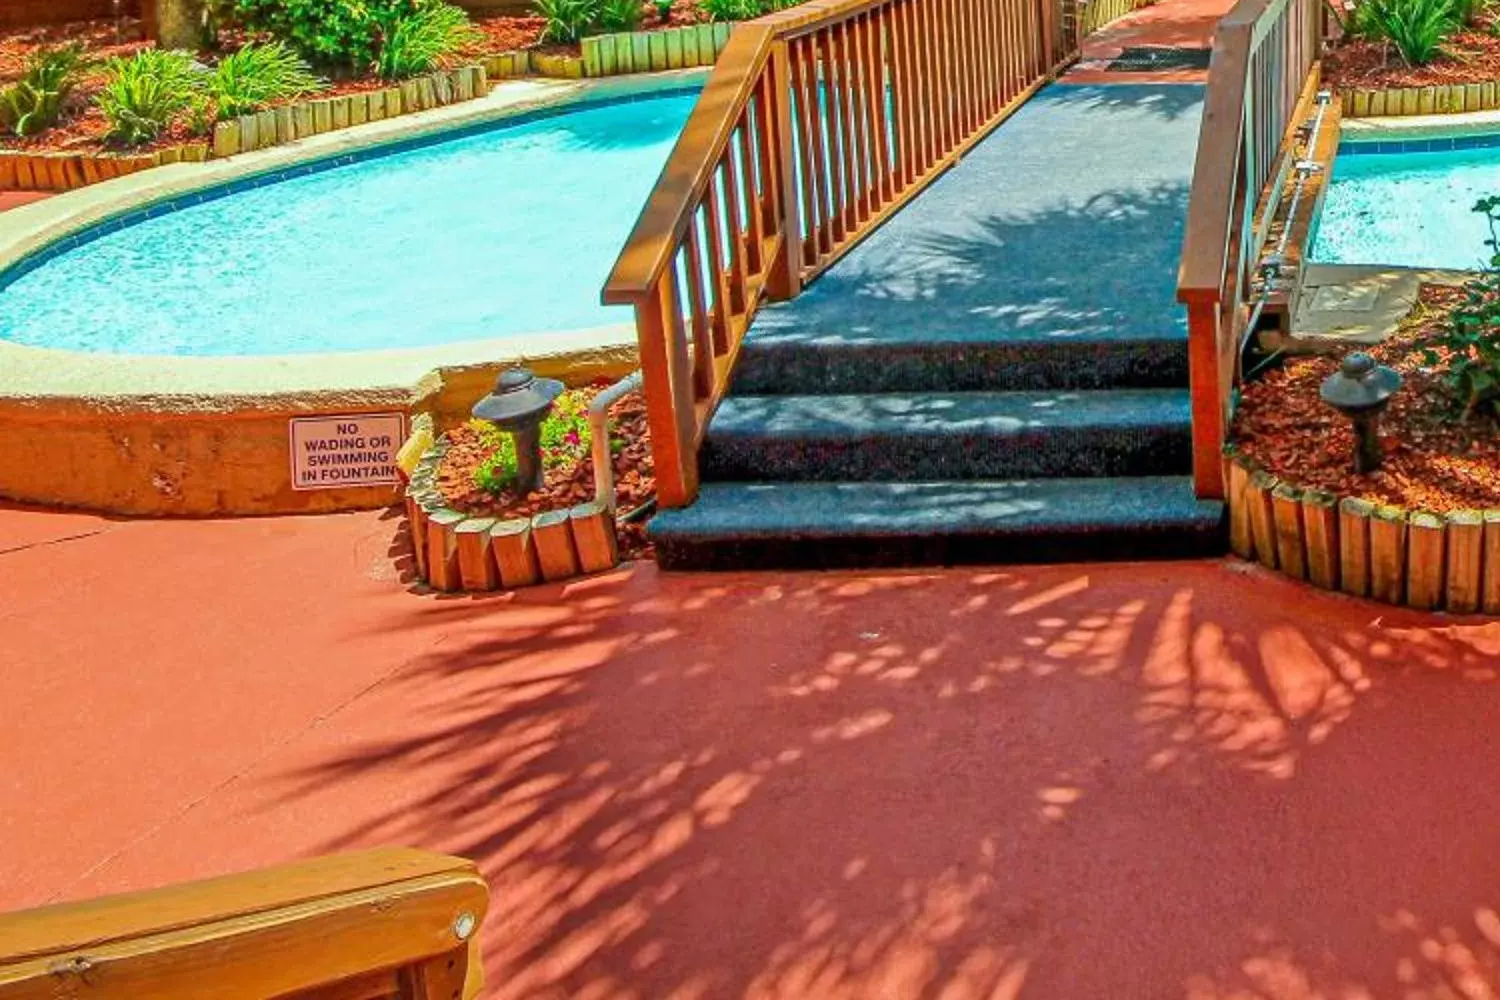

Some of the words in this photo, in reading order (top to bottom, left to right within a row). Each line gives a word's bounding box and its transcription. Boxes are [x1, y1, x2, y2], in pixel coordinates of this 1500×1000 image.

[337, 423, 359, 435] NO
[305, 437, 365, 452] WADING
[369, 435, 391, 448] OR
[307, 451, 389, 467] SWIMMING
[301, 469, 317, 482] IN
[321, 465, 396, 481] FOUNTAIN
